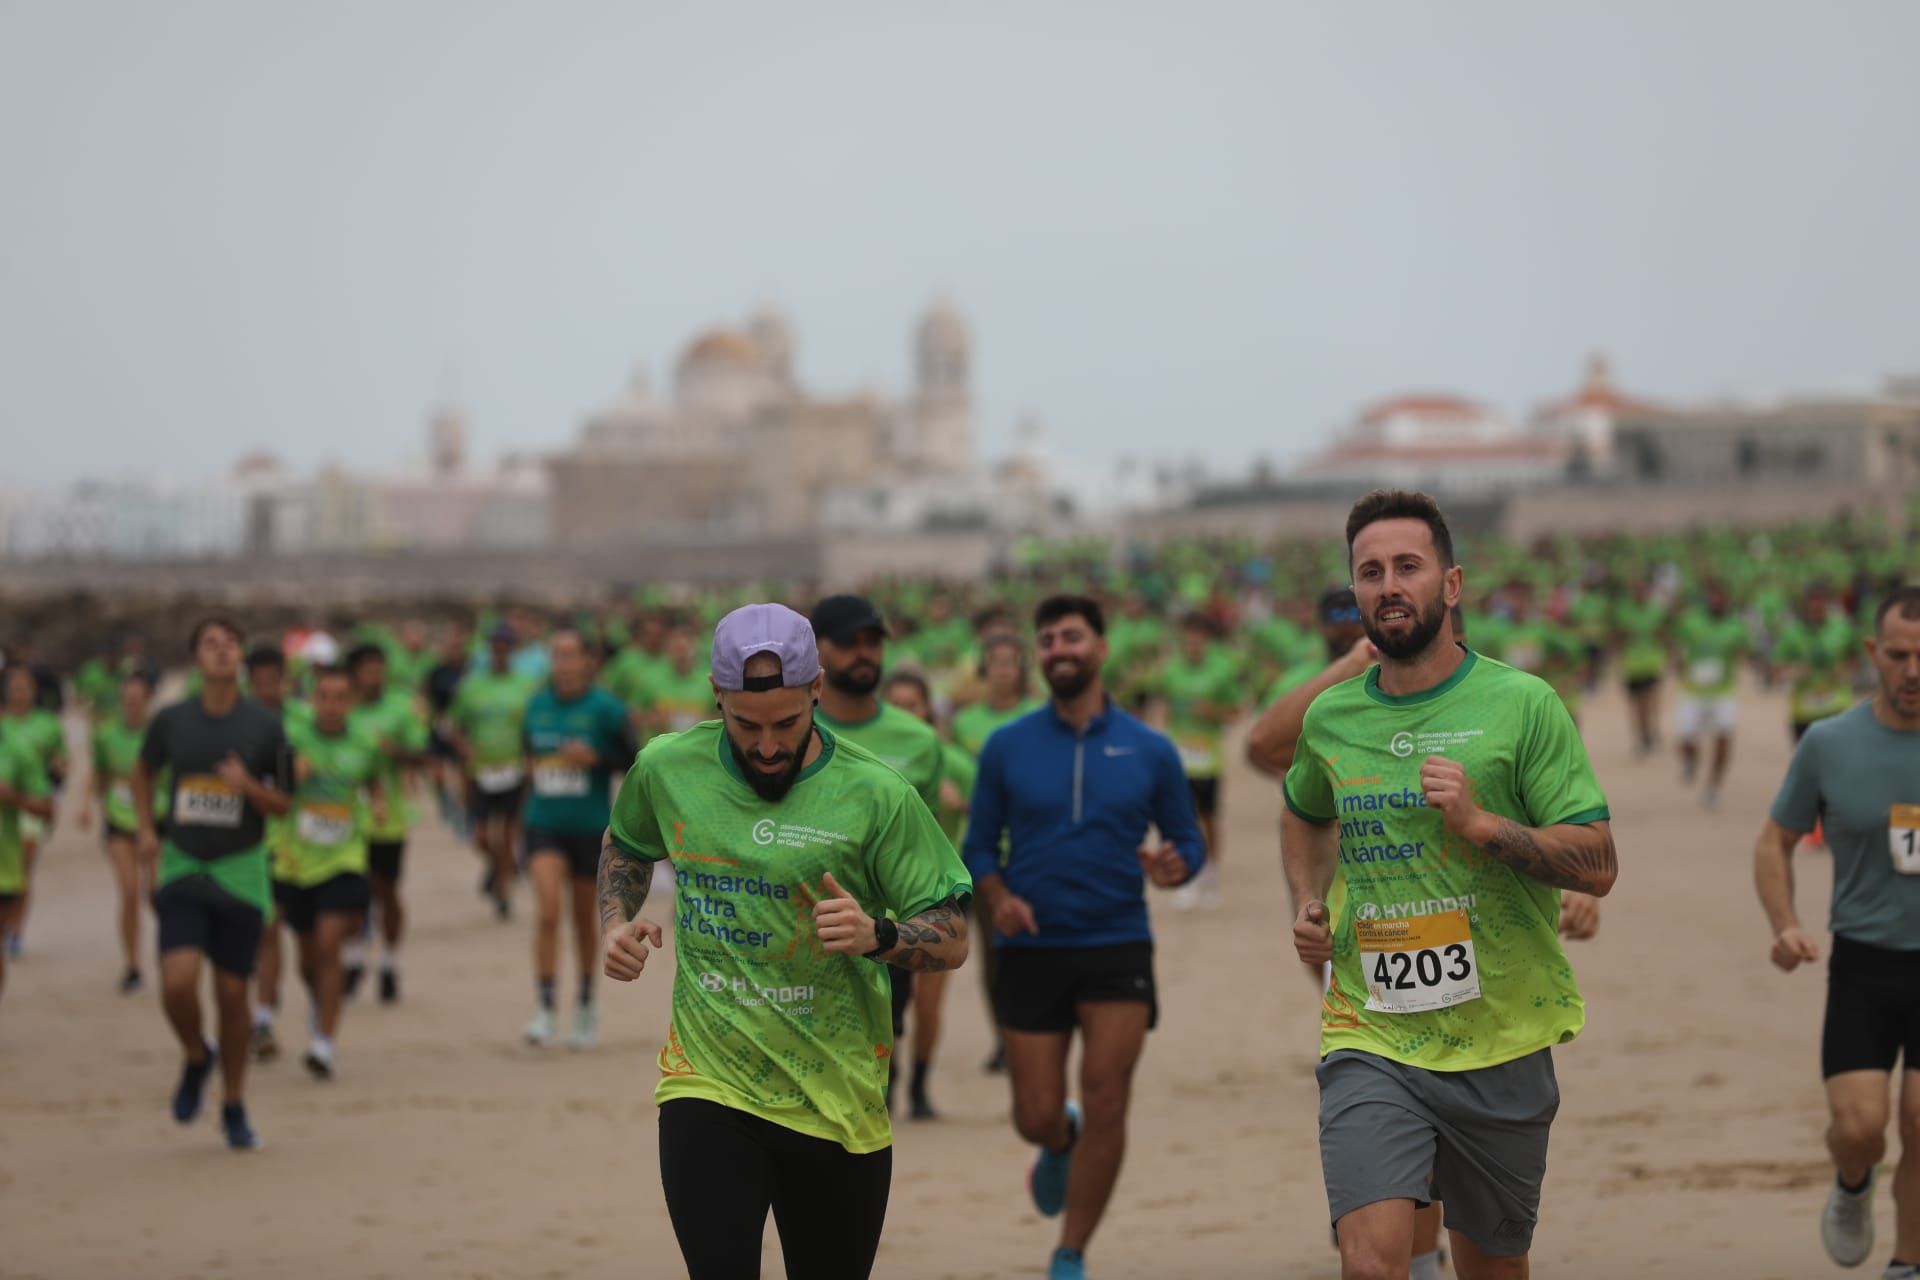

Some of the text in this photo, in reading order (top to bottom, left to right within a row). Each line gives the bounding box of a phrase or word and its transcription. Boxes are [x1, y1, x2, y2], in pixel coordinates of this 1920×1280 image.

[1343, 787, 1428, 813] marcha
[1340, 817, 1386, 838] ntra
[1351, 841, 1425, 864] cáncer
[1901, 828, 1920, 857] 1
[695, 871, 789, 900] marcha
[1383, 894, 1477, 919] HYUNDAI
[1383, 920, 1410, 929] marcha
[1384, 929, 1409, 937] cáncer
[1374, 943, 1471, 990] 4203
